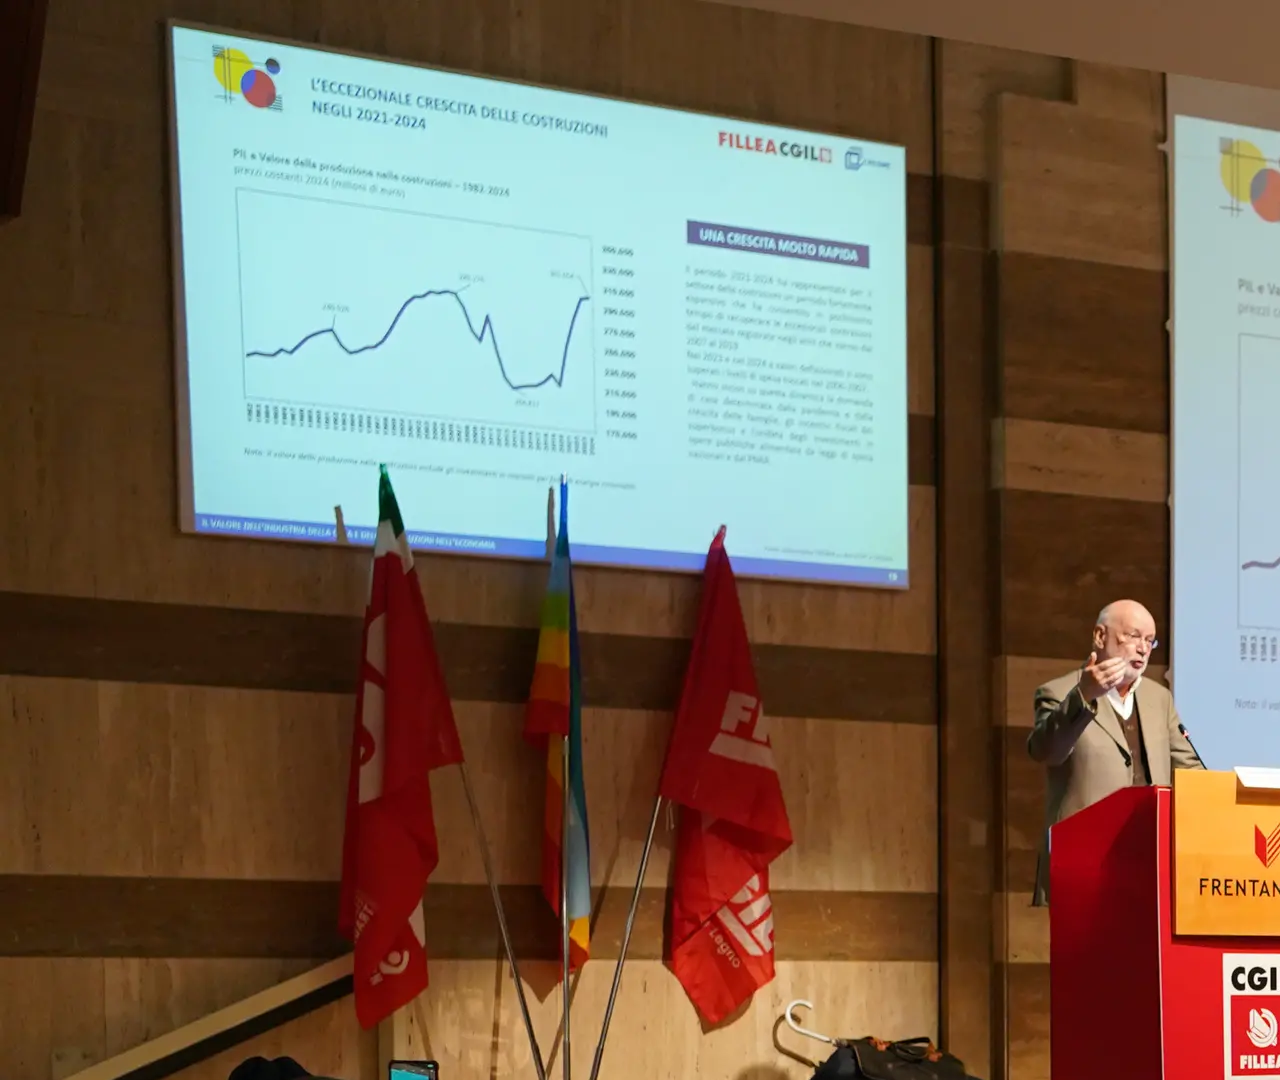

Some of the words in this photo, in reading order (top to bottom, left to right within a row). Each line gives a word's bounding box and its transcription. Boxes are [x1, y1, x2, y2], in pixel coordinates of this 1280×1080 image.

[312, 101, 352, 119] NEGLI
[357, 107, 426, 130] 2021-2024
[416, 95, 478, 117] CRESCITA
[480, 105, 519, 124] DELLE
[522, 112, 608, 138] COSTRUZIONI
[700, 227, 726, 244] UNA
[726, 231, 777, 250] CRESCITA
[778, 239, 817, 256] MOLTO
[818, 244, 859, 262] RAPIDA
